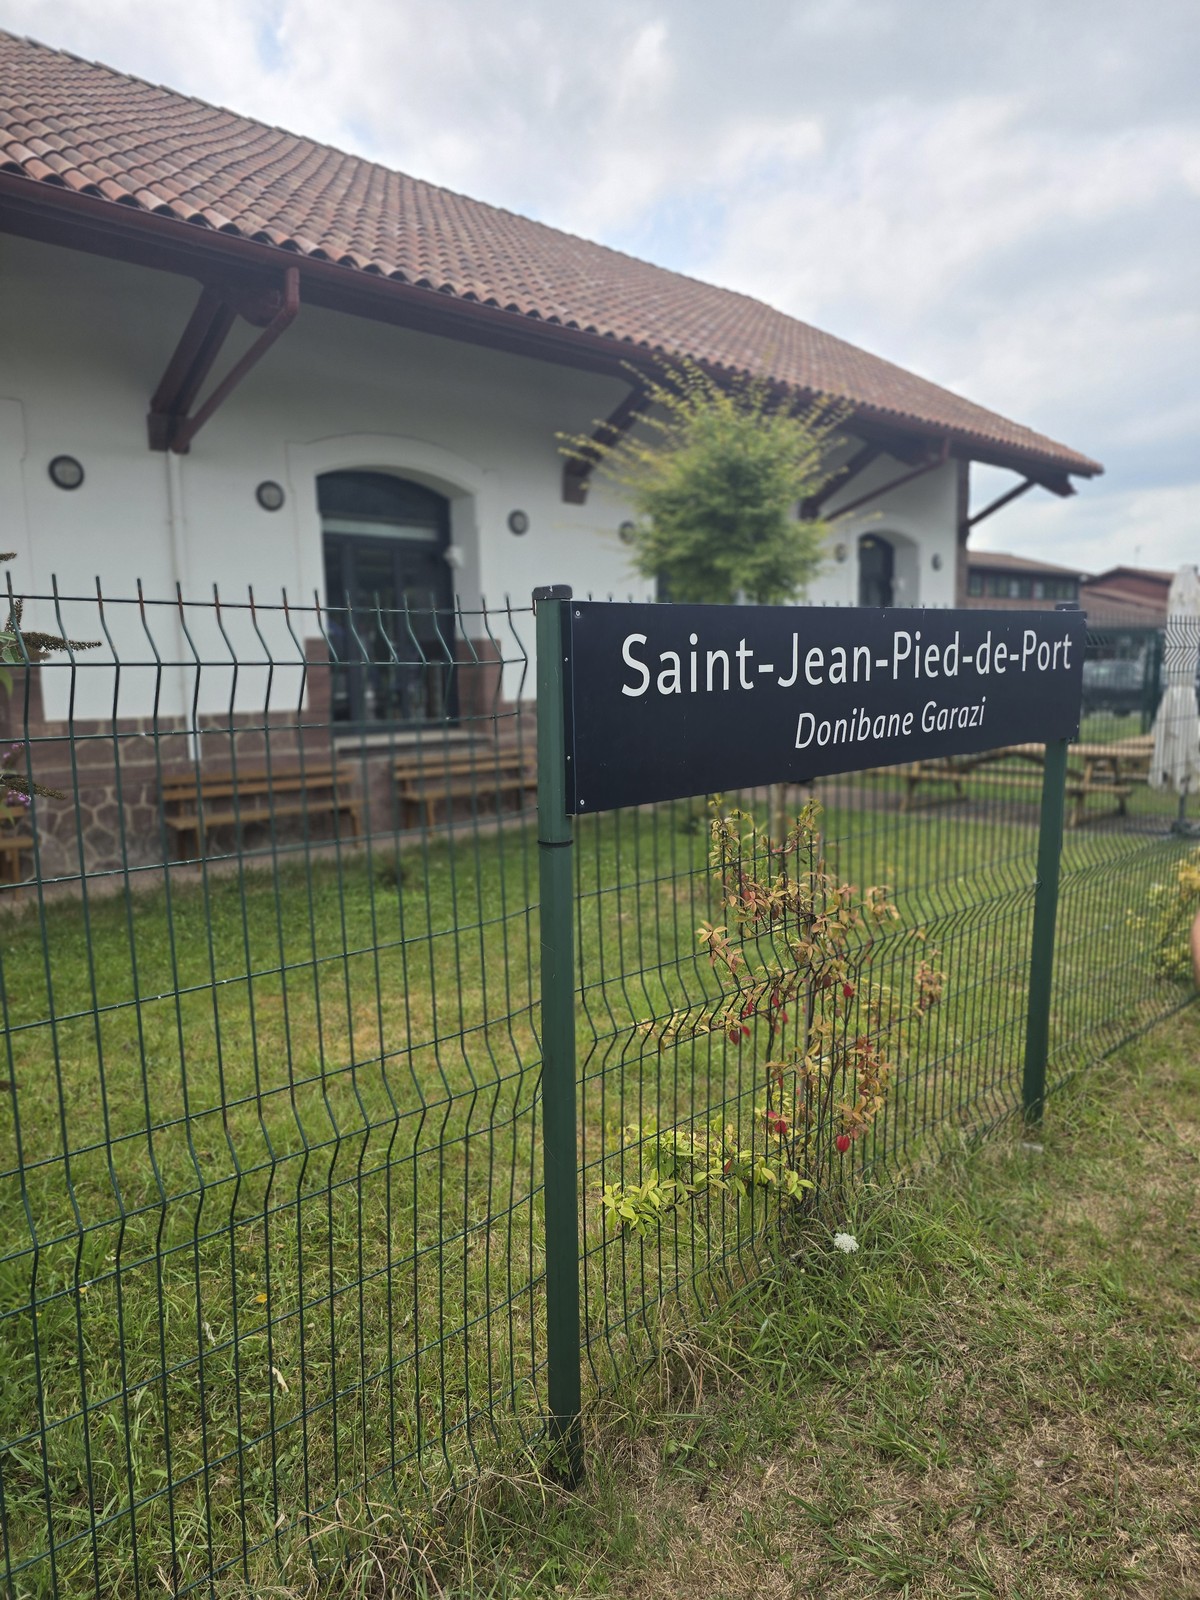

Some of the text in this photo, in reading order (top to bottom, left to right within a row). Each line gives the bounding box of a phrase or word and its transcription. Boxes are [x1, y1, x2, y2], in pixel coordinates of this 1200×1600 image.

[621, 629, 1073, 697] Saint-Jean-Pied-de-Port
[794, 695, 987, 749] Donibane Garazi
